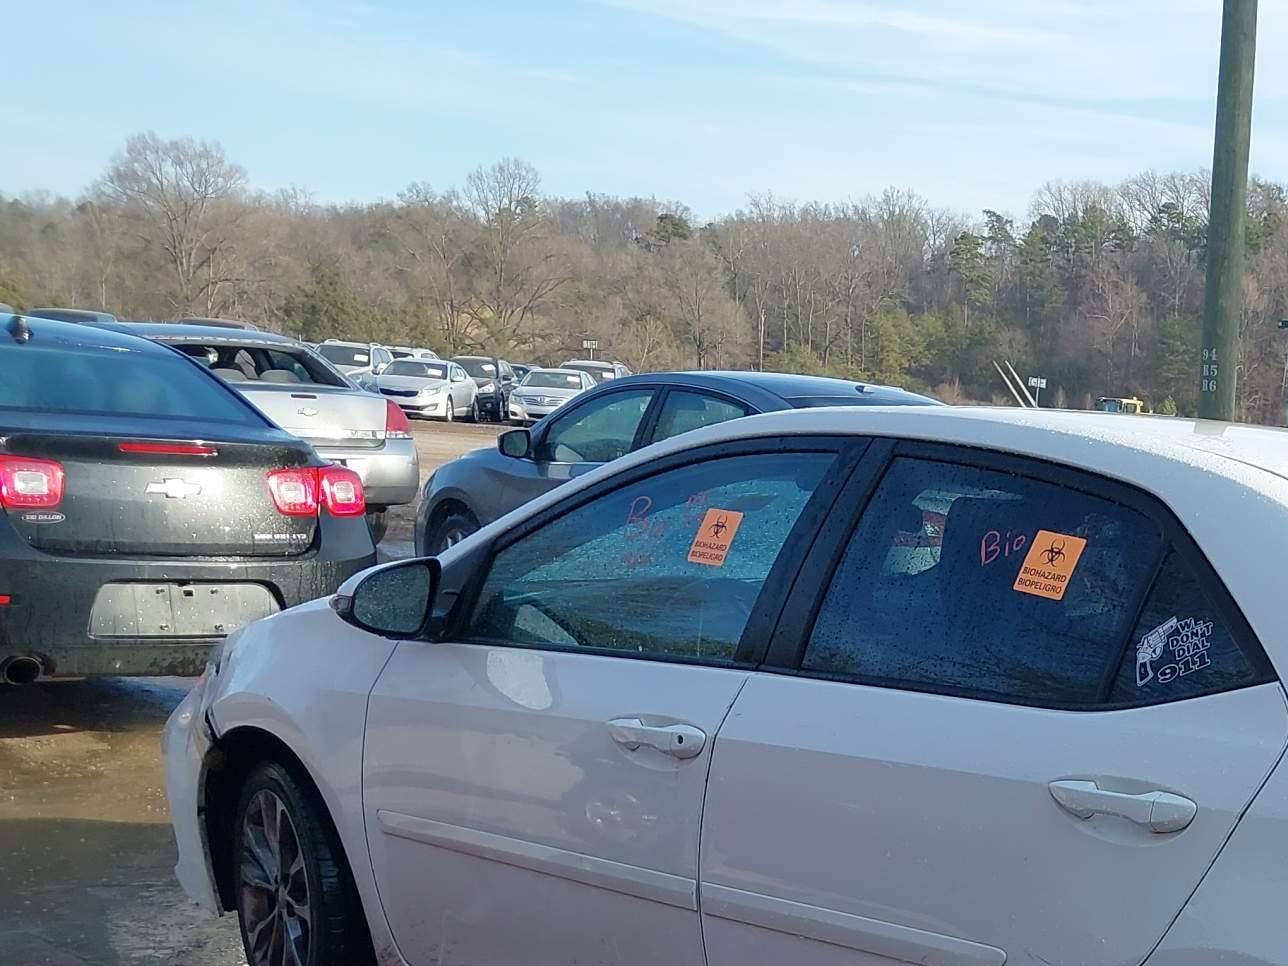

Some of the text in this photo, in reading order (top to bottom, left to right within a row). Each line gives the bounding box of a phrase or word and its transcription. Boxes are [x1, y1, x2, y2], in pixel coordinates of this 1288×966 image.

[691, 550, 724, 561] BIOPELIGRO
[694, 540, 728, 552] BIOHAZARD
[981, 530, 1026, 567] Bio
[1022, 566, 1067, 583] BIOHAZARD
[1017, 577, 1063, 594] BIOPELIGRO
[1169, 621, 1214, 650] DON'T
[1176, 637, 1211, 660] DIAL
[1157, 650, 1211, 683] 911
